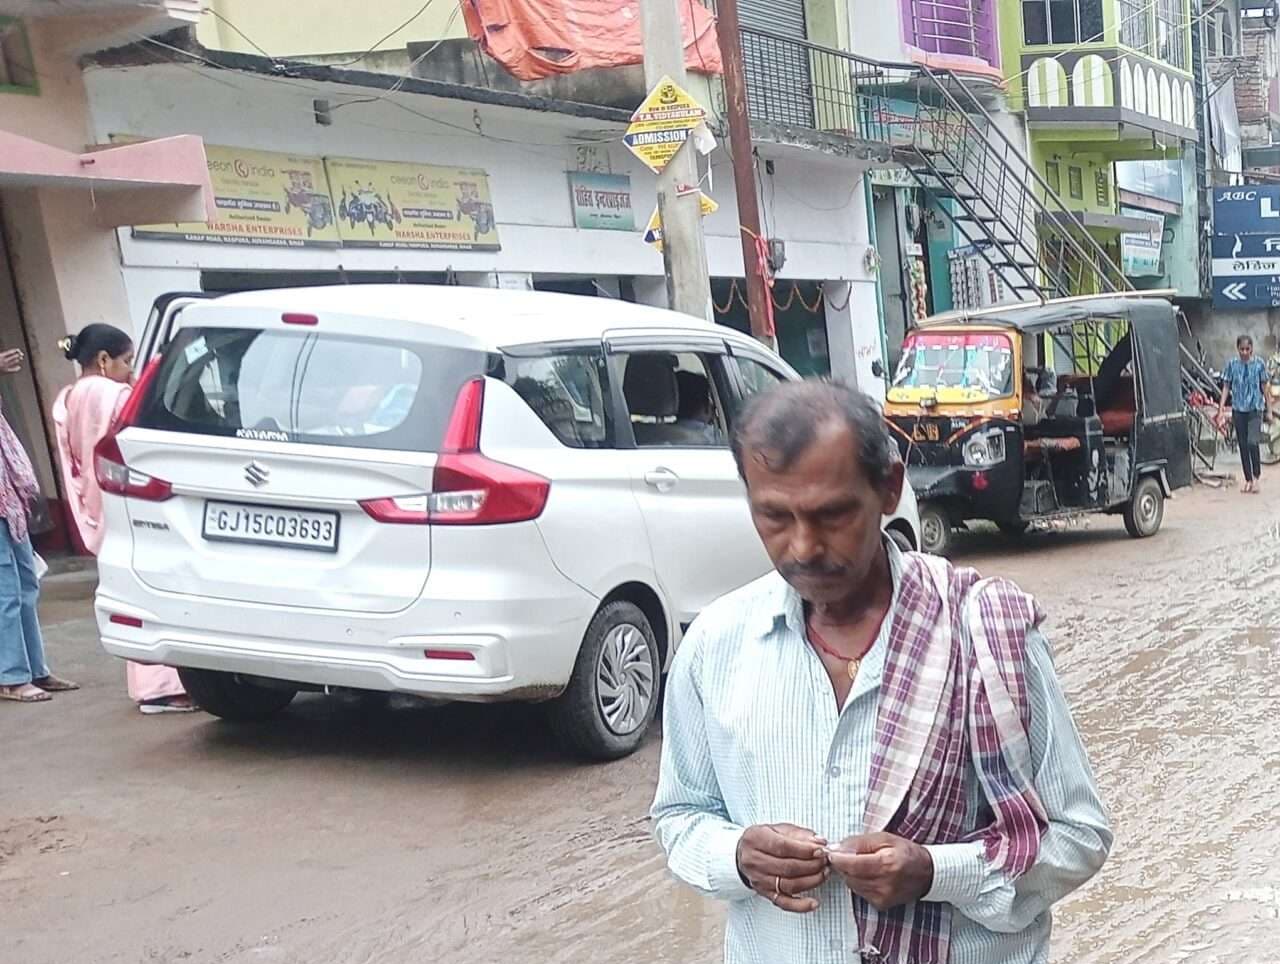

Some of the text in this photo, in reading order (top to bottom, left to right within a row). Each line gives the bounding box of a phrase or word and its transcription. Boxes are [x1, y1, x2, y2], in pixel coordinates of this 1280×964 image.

[632, 130, 687, 145] ADMISSION
[1217, 190, 1257, 202] ABC
[246, 225, 303, 236] ENTERPRISES
[426, 231, 471, 240] ENTERPRISES
[236, 428, 289, 442] KATARIA
[217, 511, 333, 541] GJ15CQ3693
